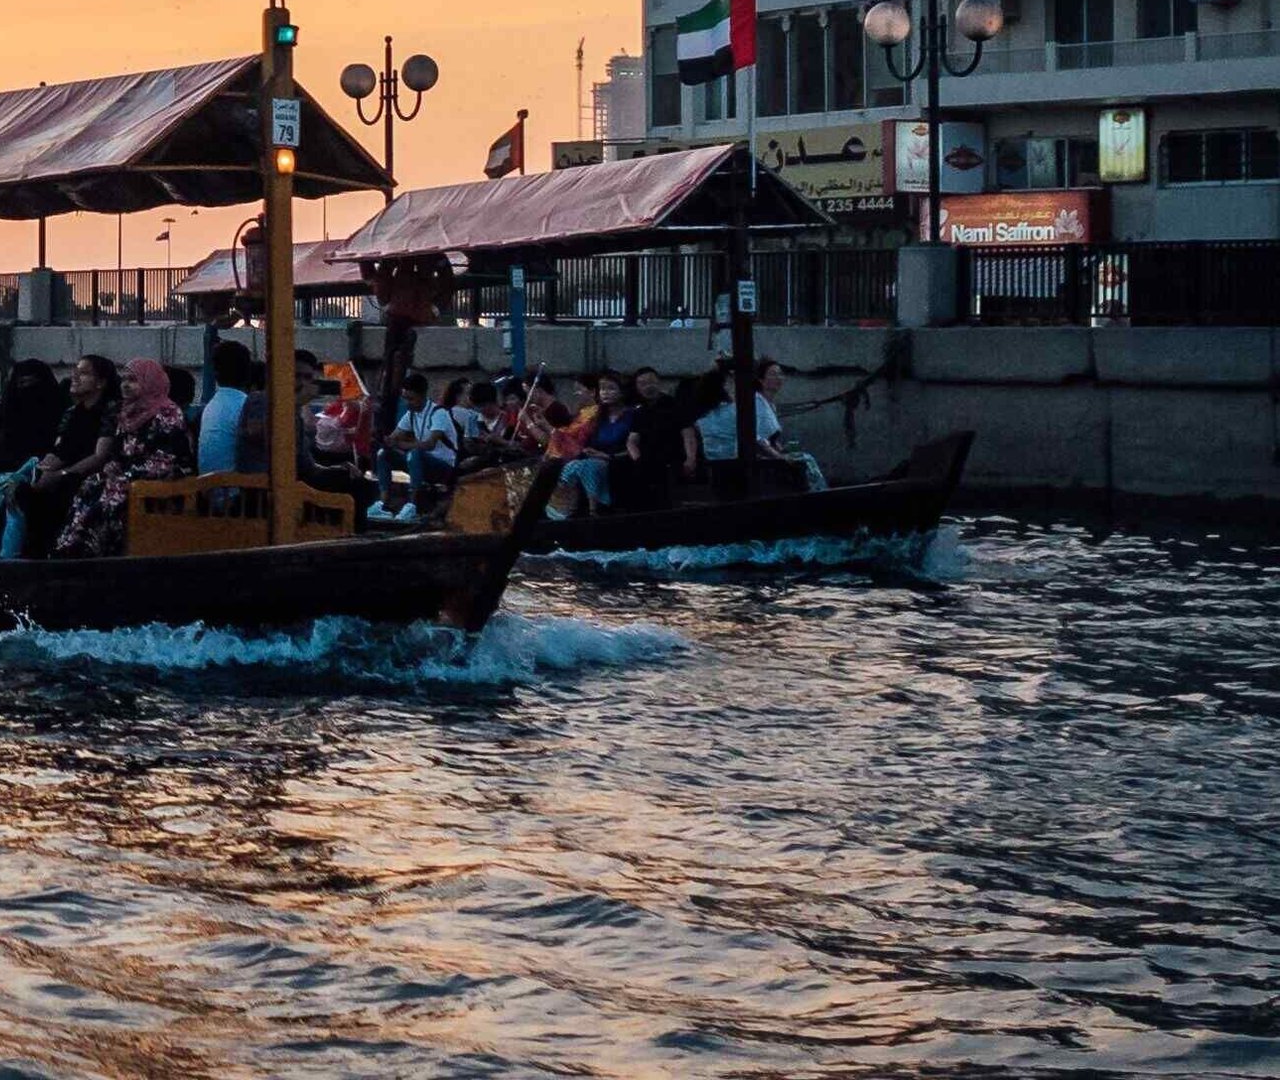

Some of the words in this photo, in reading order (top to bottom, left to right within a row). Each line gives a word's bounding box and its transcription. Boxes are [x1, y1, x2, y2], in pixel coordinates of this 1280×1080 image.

[278, 124, 295, 142] 79
[826, 199, 854, 213] 235
[857, 196, 895, 210] 4444
[951, 223, 993, 243] Nami
[996, 221, 1055, 242] Saffron
